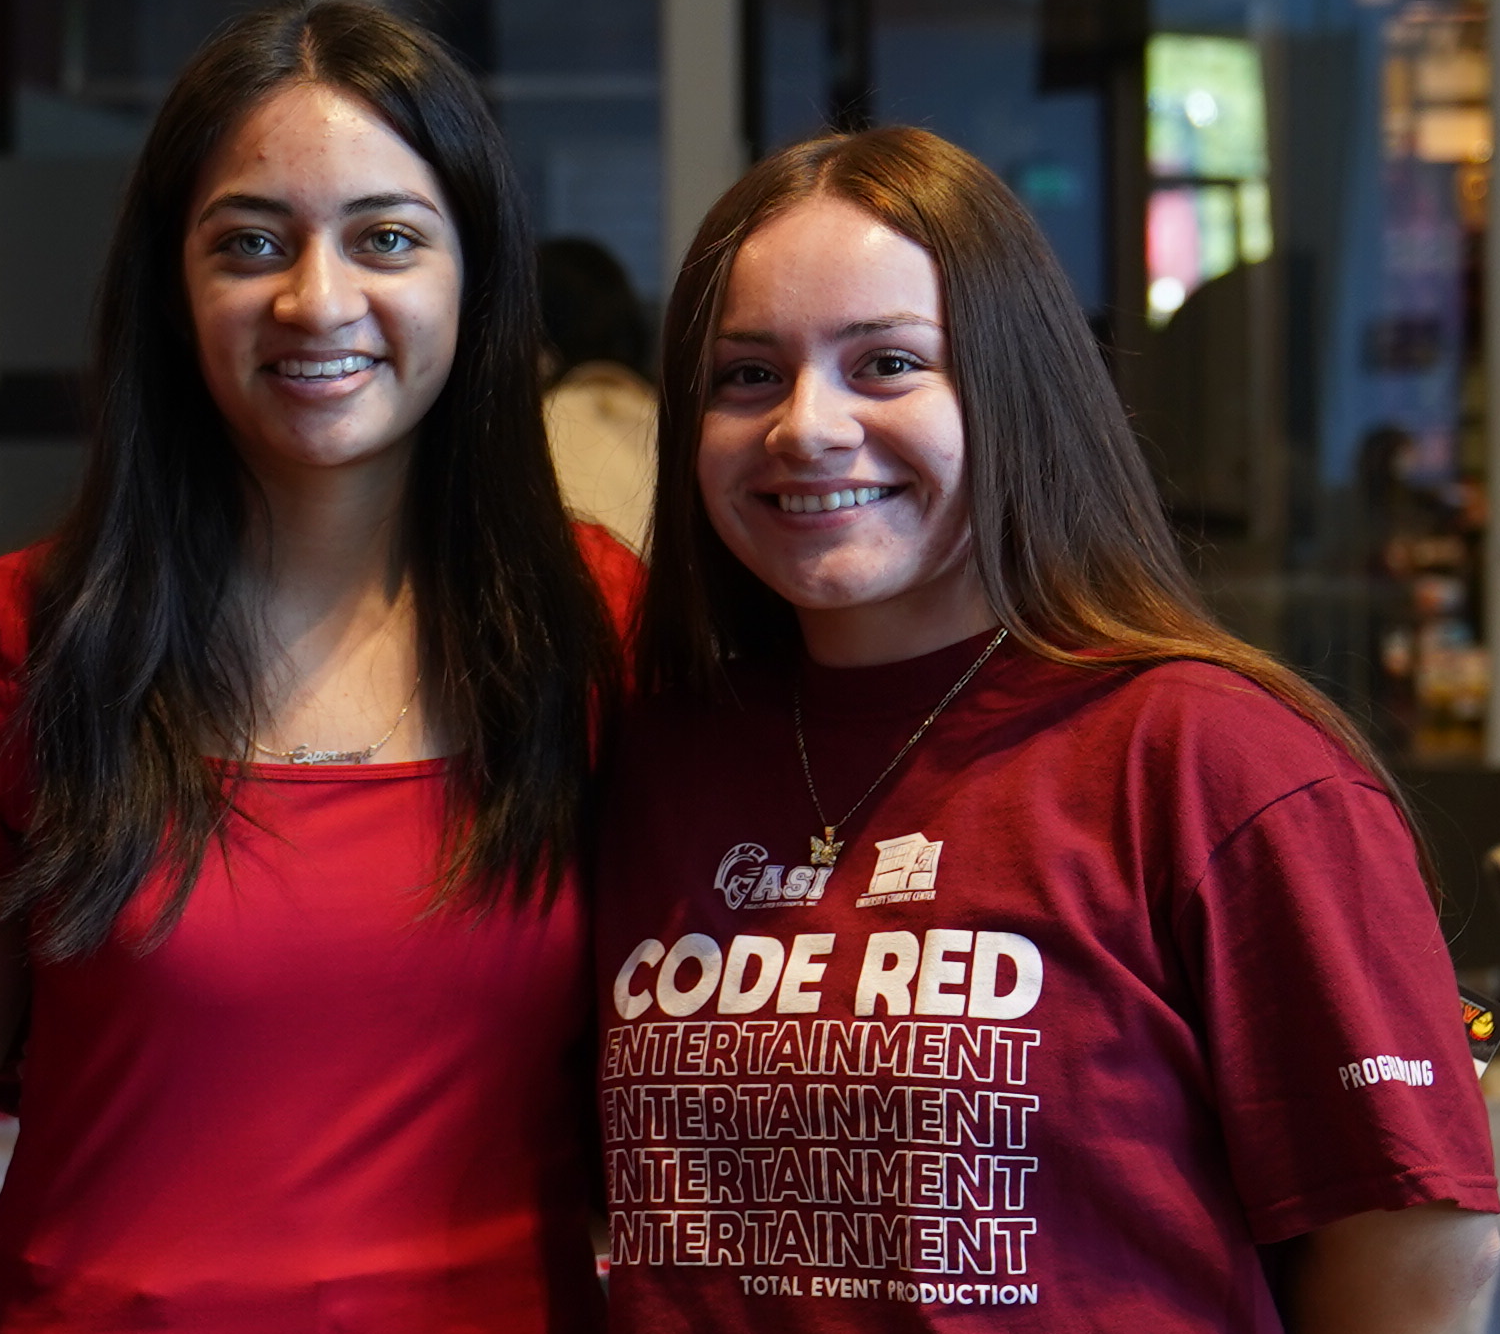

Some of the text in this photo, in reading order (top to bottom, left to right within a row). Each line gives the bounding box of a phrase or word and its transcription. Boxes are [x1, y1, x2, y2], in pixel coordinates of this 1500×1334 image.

[750, 864, 834, 902] ASI
[613, 928, 1044, 1020] CODE RED
[602, 1019, 1040, 1085] ENTERTAINMENT
[608, 1209, 1037, 1275] NTERTAINMENT
[740, 1275, 1039, 1305] TOTAL EVENT PRODUCTION
